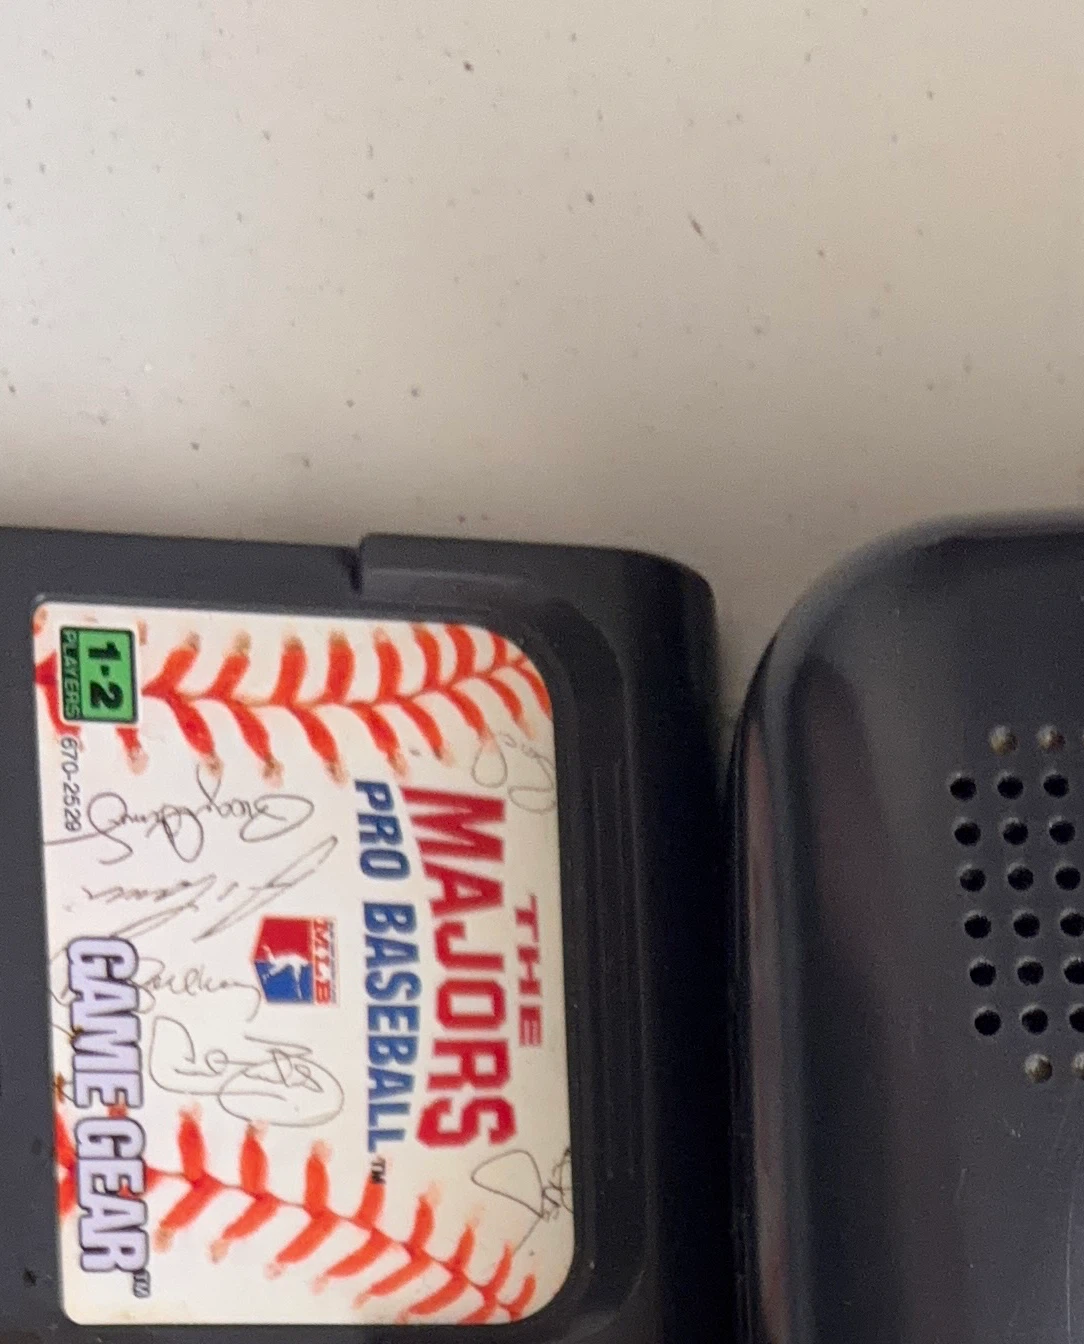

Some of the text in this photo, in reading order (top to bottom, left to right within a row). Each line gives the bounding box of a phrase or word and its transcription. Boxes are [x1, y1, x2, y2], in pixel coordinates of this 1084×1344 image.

[63, 630, 81, 720] PLAYERS
[88, 641, 125, 710] 1-2
[60, 736, 82, 832] 670-2529
[355, 779, 411, 881] PRO
[67, 935, 144, 1109] GAME
[362, 901, 422, 1153] BASEBALL
[401, 785, 517, 1150] MAJORS
[514, 893, 542, 1047] THE
[75, 1115, 148, 1274] GEAR
